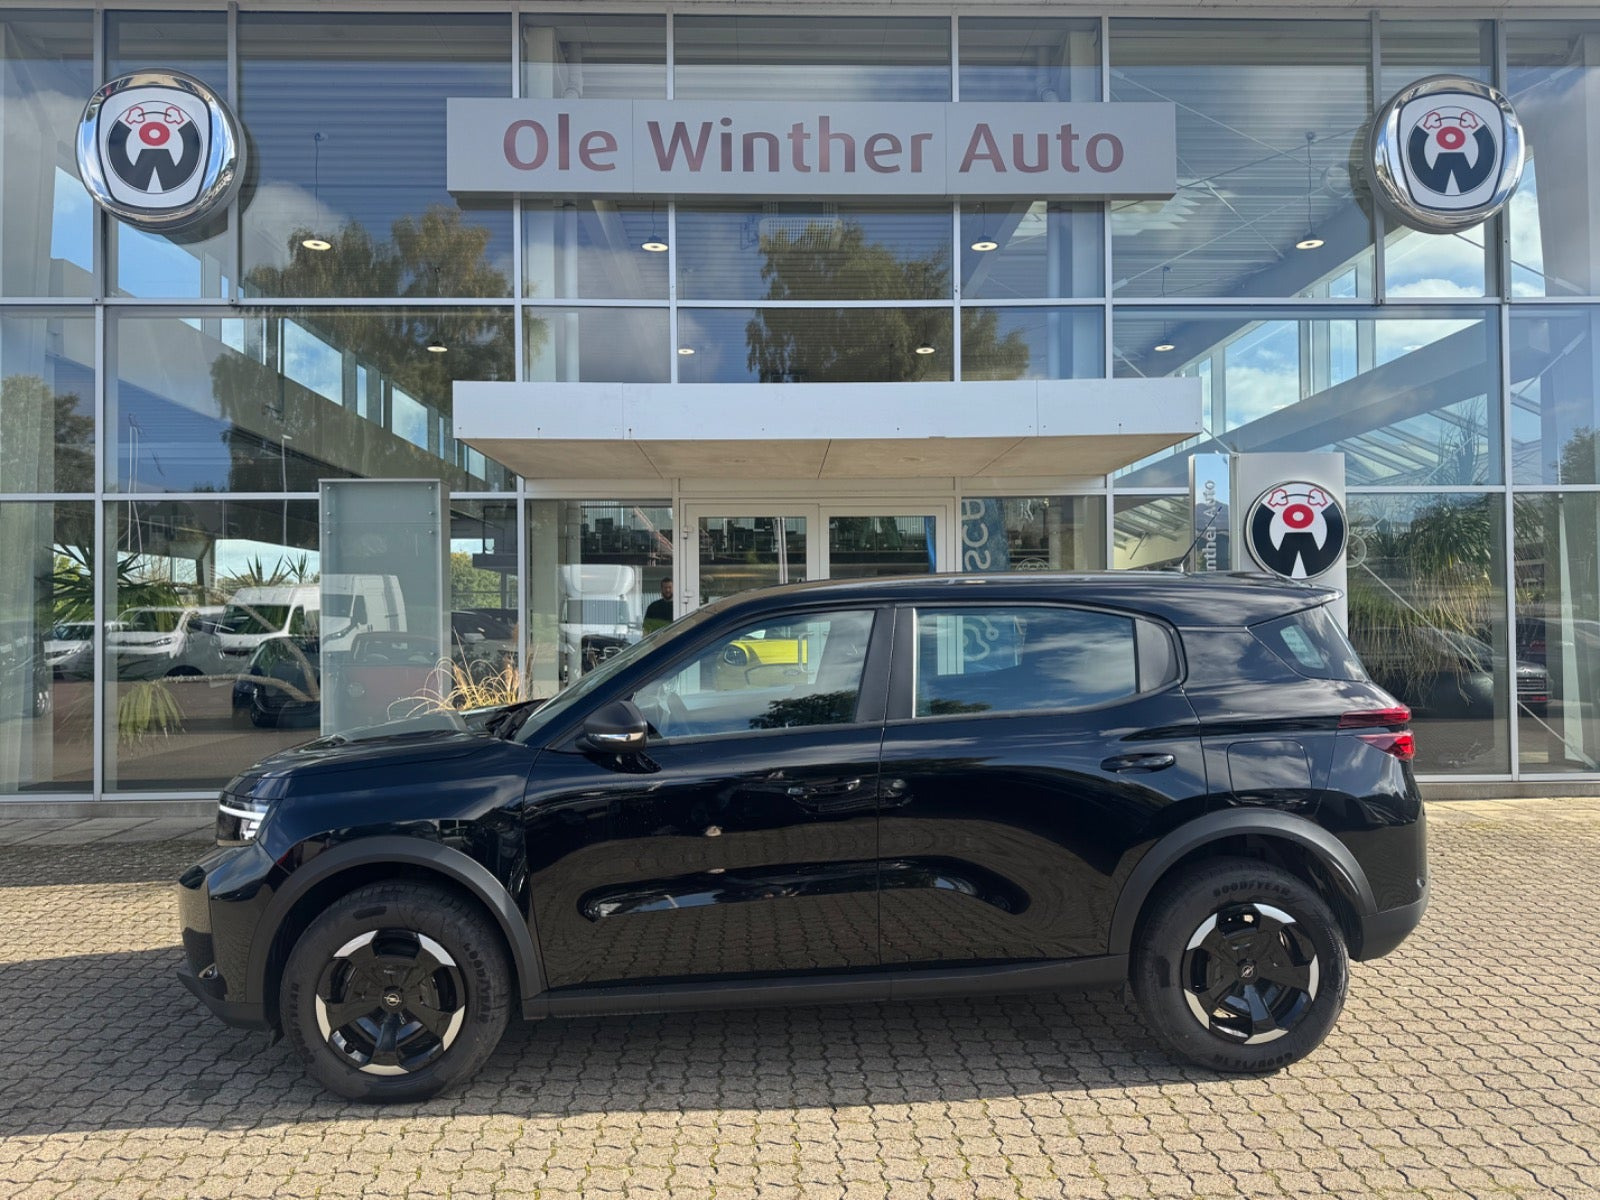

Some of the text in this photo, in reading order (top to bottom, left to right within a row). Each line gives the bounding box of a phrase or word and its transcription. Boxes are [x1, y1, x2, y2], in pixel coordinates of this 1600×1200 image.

[502, 113, 1125, 174] Ole Winther Auto
[1203, 479, 1216, 517] Auto
